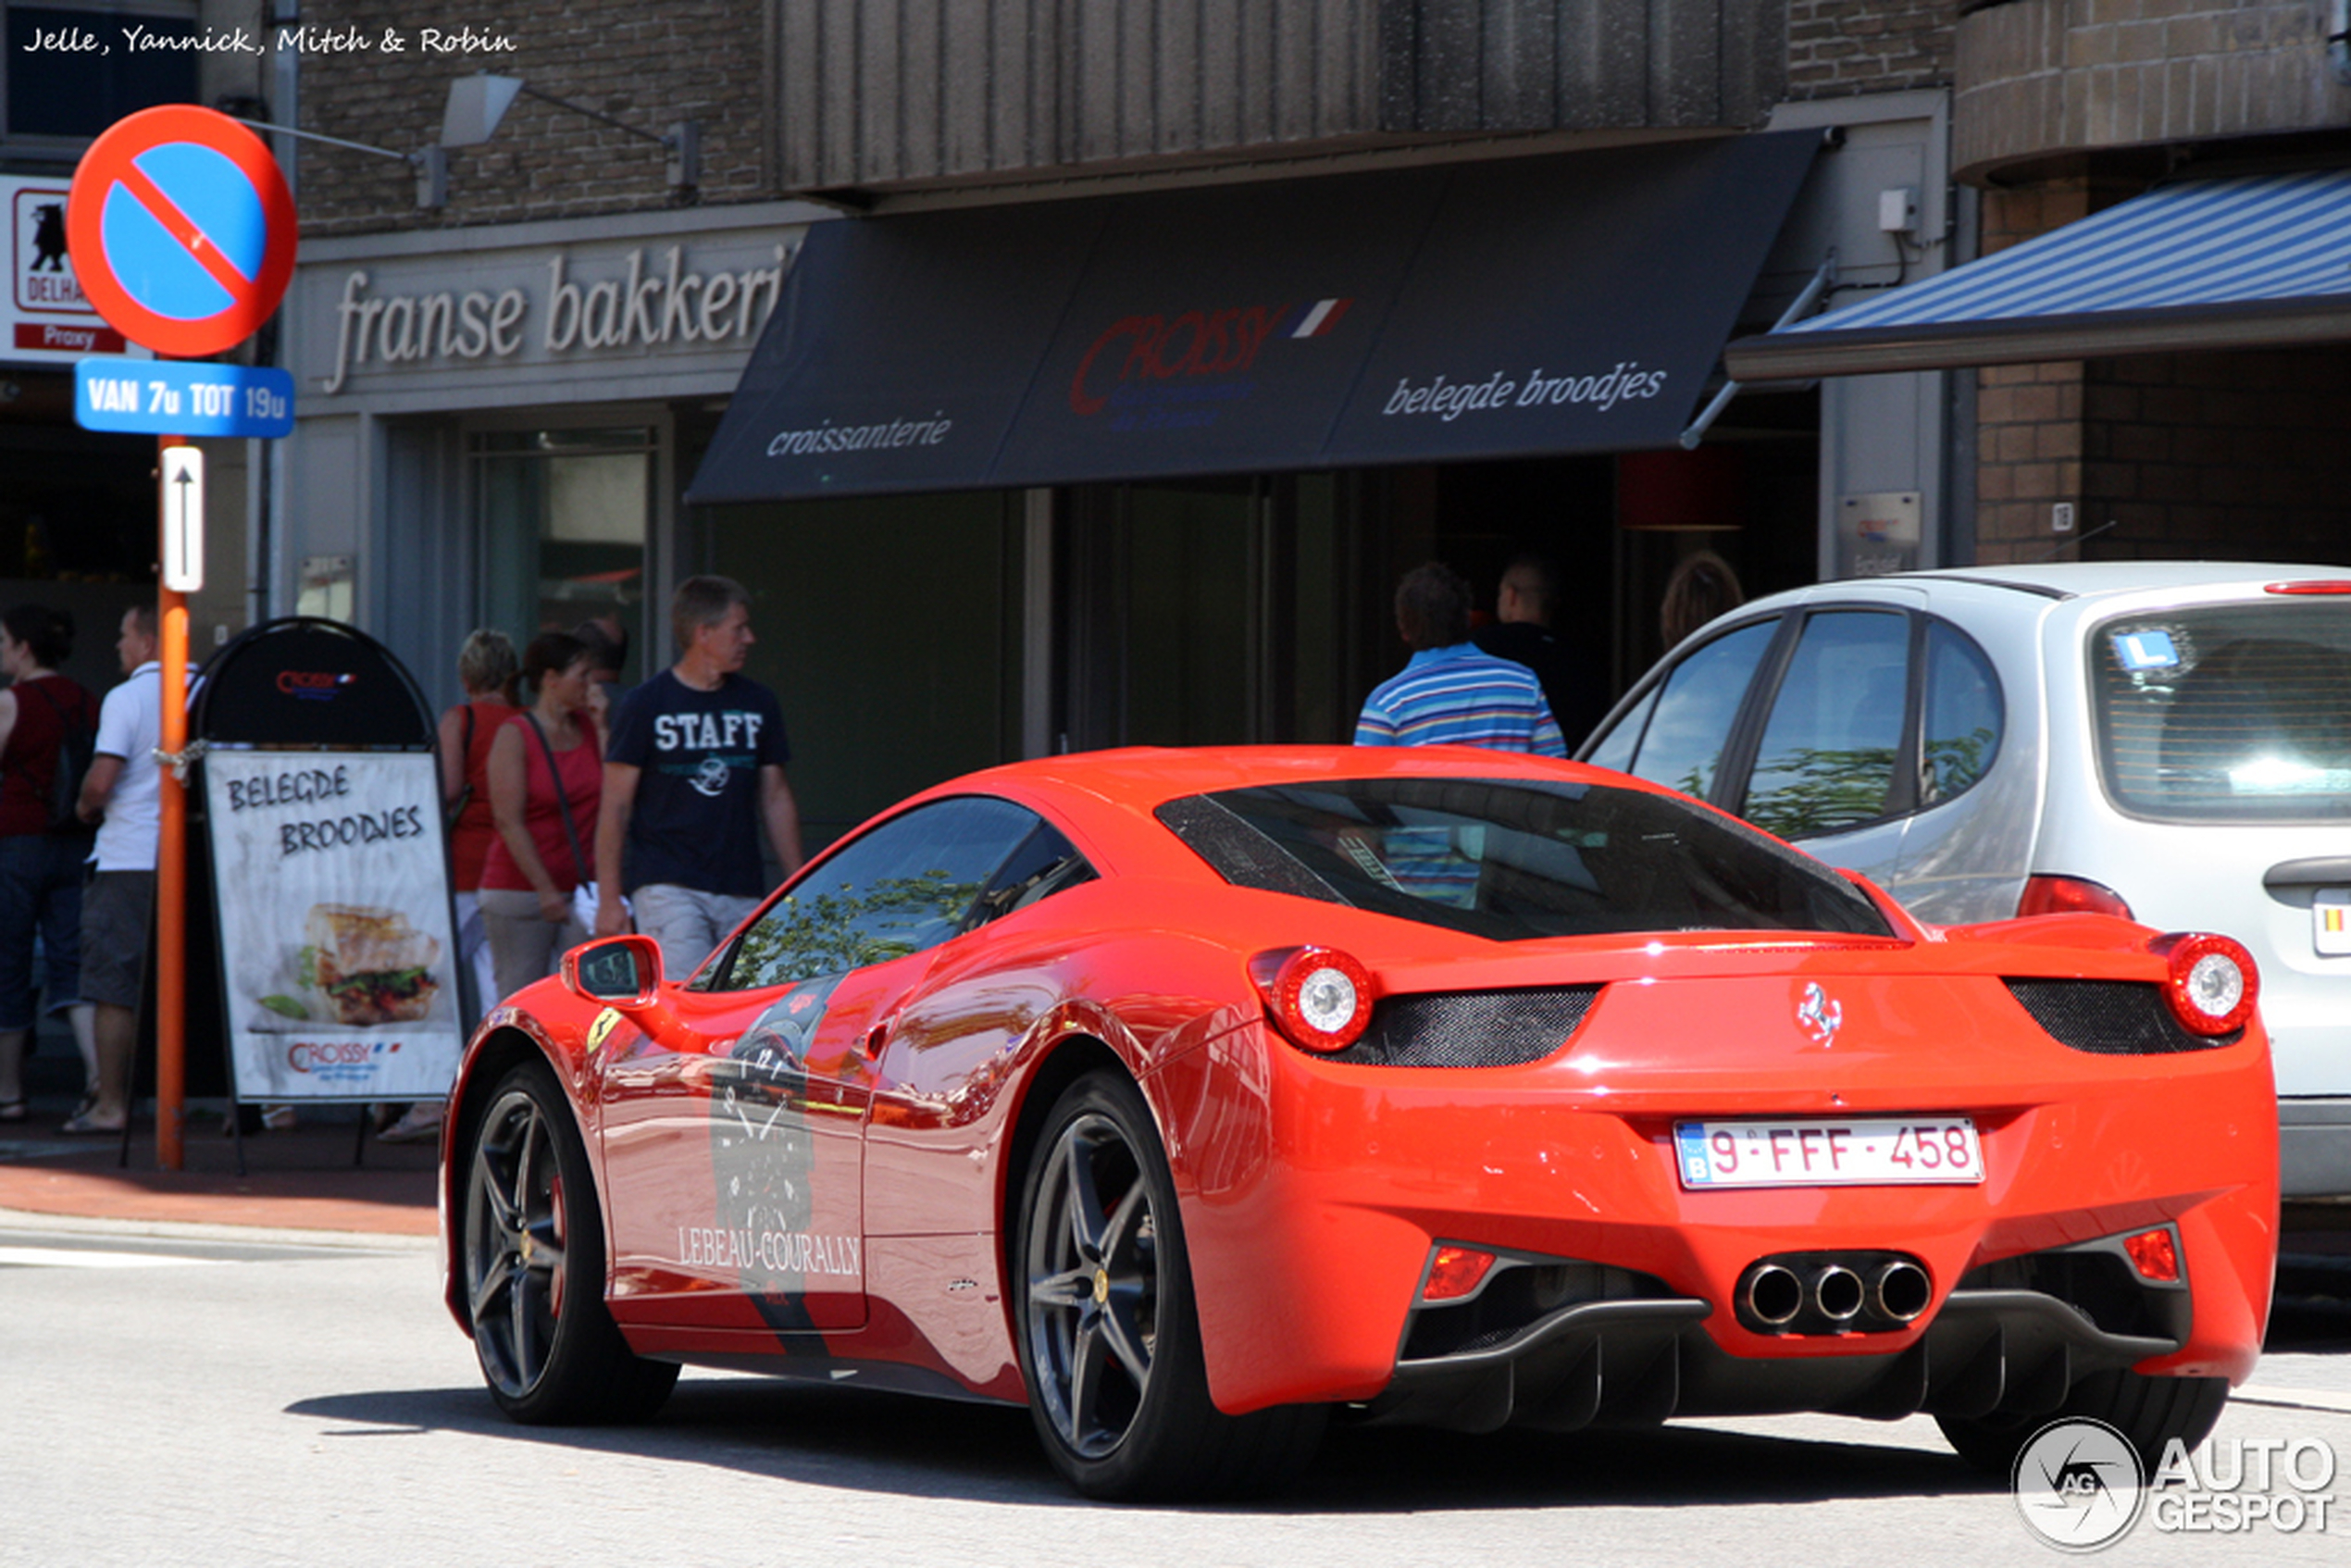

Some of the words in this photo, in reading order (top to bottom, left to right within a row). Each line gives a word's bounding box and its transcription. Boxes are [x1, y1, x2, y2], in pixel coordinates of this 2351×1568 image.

[28, 276, 87, 303] DELHA
[44, 324, 95, 351] Proxy
[323, 270, 526, 394] franse
[543, 243, 790, 352] bakkeri
[87, 378, 138, 413] VAN
[148, 380, 180, 415] 7u
[189, 383, 234, 416] TOT
[245, 386, 286, 418] 19u
[1382, 370, 1516, 421] belegde
[1514, 360, 1667, 412] broodjes
[765, 408, 952, 457] croissanterie
[2126, 636, 2168, 665] L
[653, 712, 763, 752] STAFF
[226, 764, 349, 812] BELEGDE
[1687, 1156, 1709, 1179] B
[678, 1226, 862, 1276] LEBEAU-COURALLY
